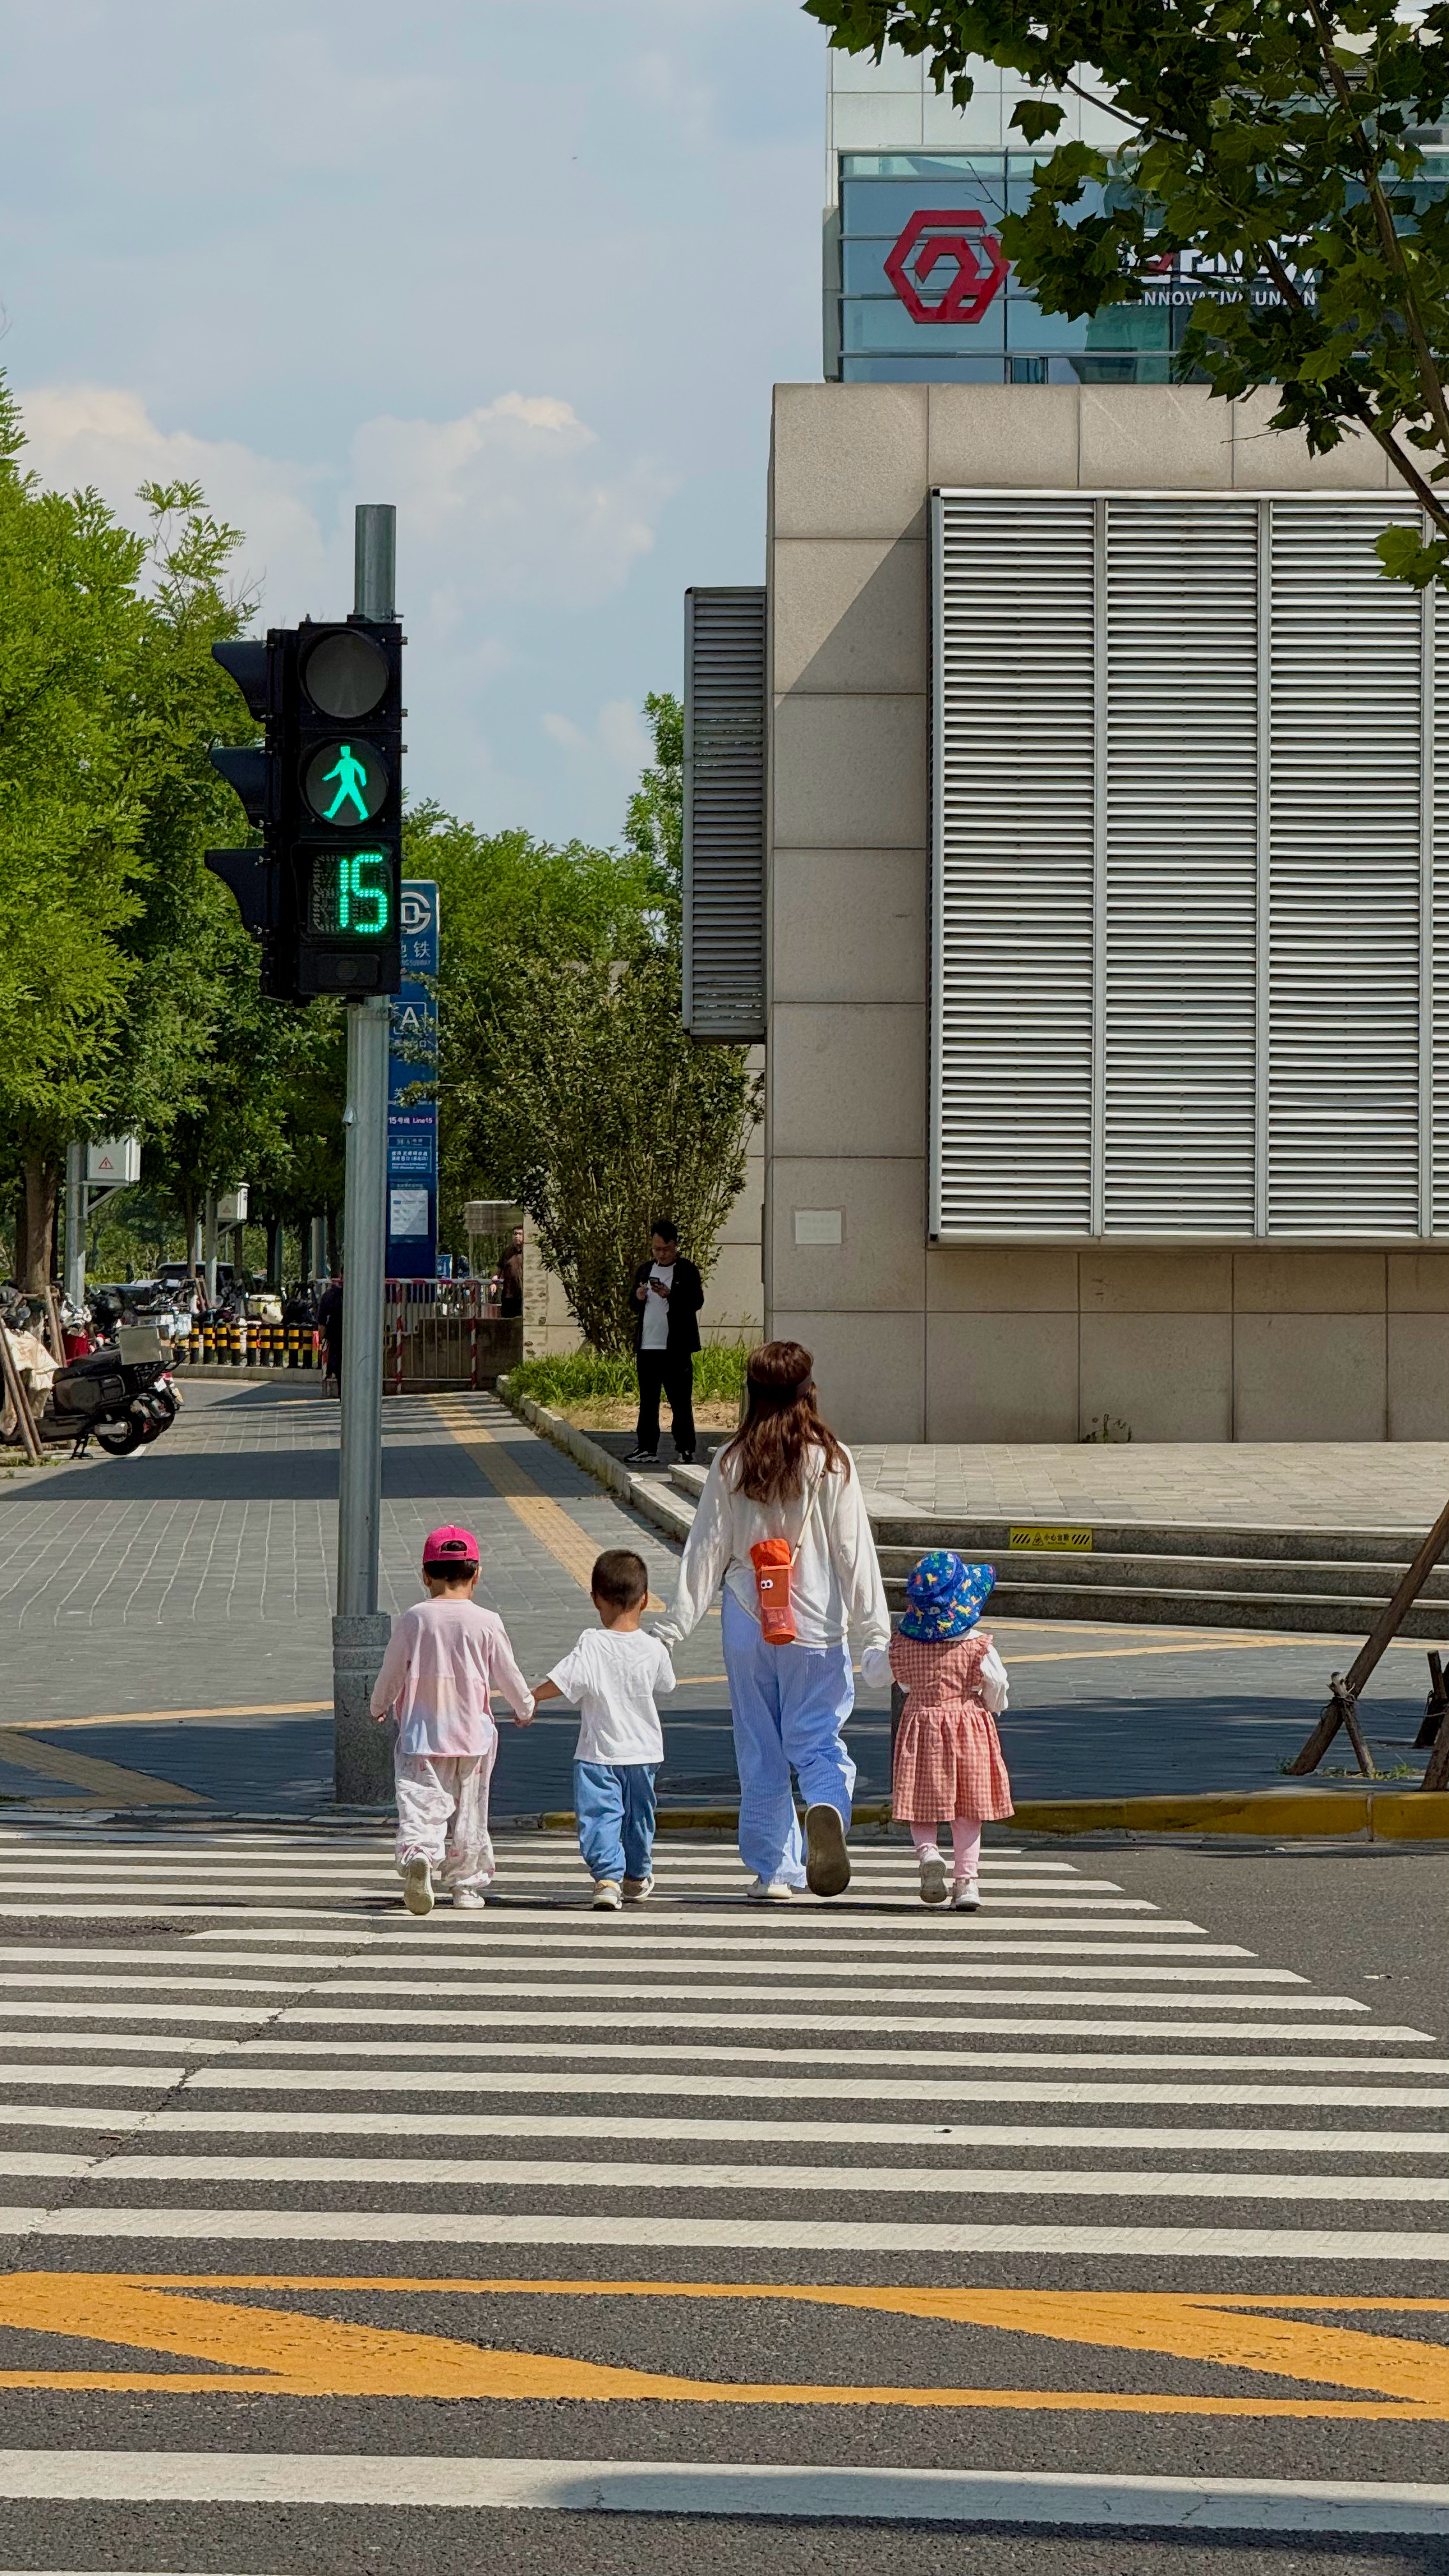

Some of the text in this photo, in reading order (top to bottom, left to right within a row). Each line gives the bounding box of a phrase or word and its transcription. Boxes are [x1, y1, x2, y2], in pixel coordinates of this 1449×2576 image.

[1255, 291, 1315, 306] UNN
[340, 854, 388, 933] 15
[399, 1006, 420, 1030] A
